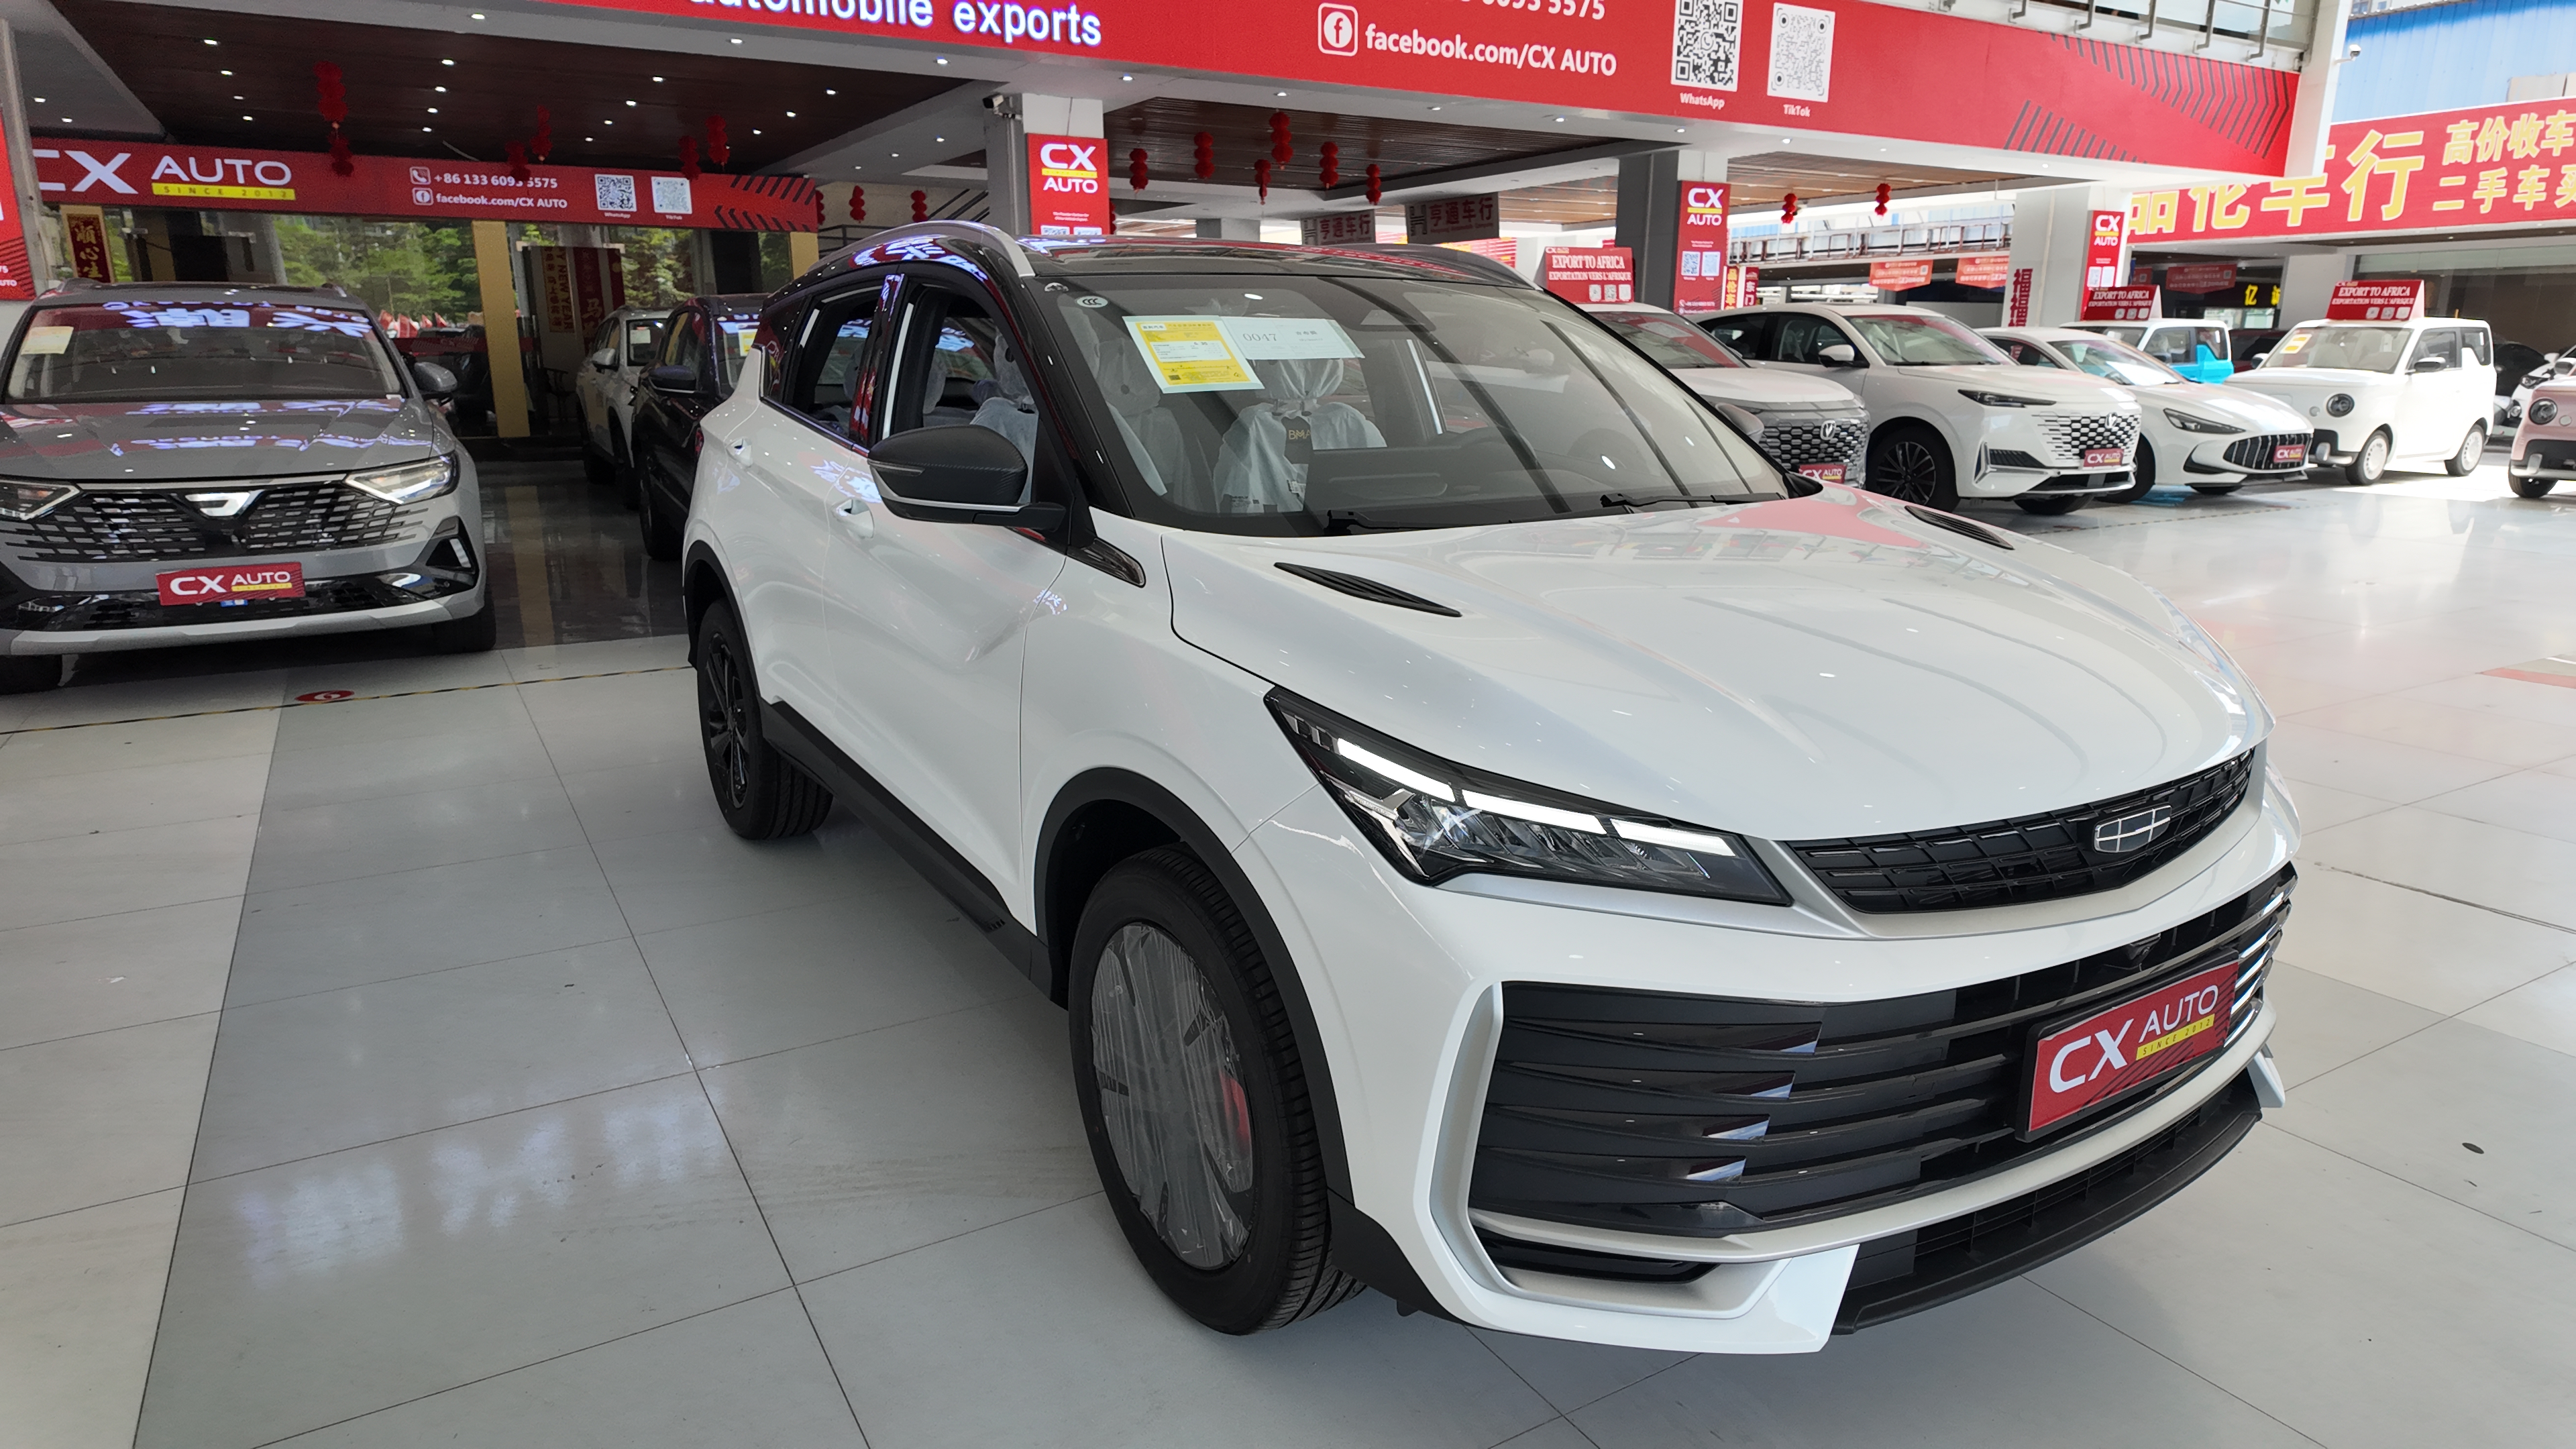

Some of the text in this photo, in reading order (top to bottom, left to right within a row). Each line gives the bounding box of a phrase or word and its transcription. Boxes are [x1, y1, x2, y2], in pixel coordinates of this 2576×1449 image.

[690, 0, 1102, 46] mobile exports
[1365, 23, 1617, 76] facebook.com/CX AUTO
[1680, 93, 1725, 110] WhatsApp
[1783, 104, 1811, 117] TikTok
[2442, 109, 2576, 166] 高价收车
[1040, 144, 1097, 171] CX
[151, 155, 292, 185] AUTO
[435, 173, 461, 184] +86
[464, 174, 488, 185] 133
[1043, 177, 1098, 193] AUTO
[163, 186, 288, 198] SINCE 2012
[1687, 188, 1723, 208] CX
[436, 193, 568, 208] facebook.com/CX AUTO
[1687, 214, 1722, 225] AUTO
[2095, 215, 2121, 231] CX
[2094, 237, 2118, 246] AUTO
[1552, 255, 1625, 269] EXPORT TO AFRICA
[2093, 290, 2149, 300] EXPORT TO AFRICA
[2338, 286, 2410, 297] EXPORT TO AFRICA
[1242, 333, 1277, 341] 0047
[2087, 453, 2104, 464] CX
[170, 571, 290, 595] CX AUTO
[2049, 985, 2218, 1093] CX AUTO
[2143, 1018, 2210, 1055] SINCE 2012
